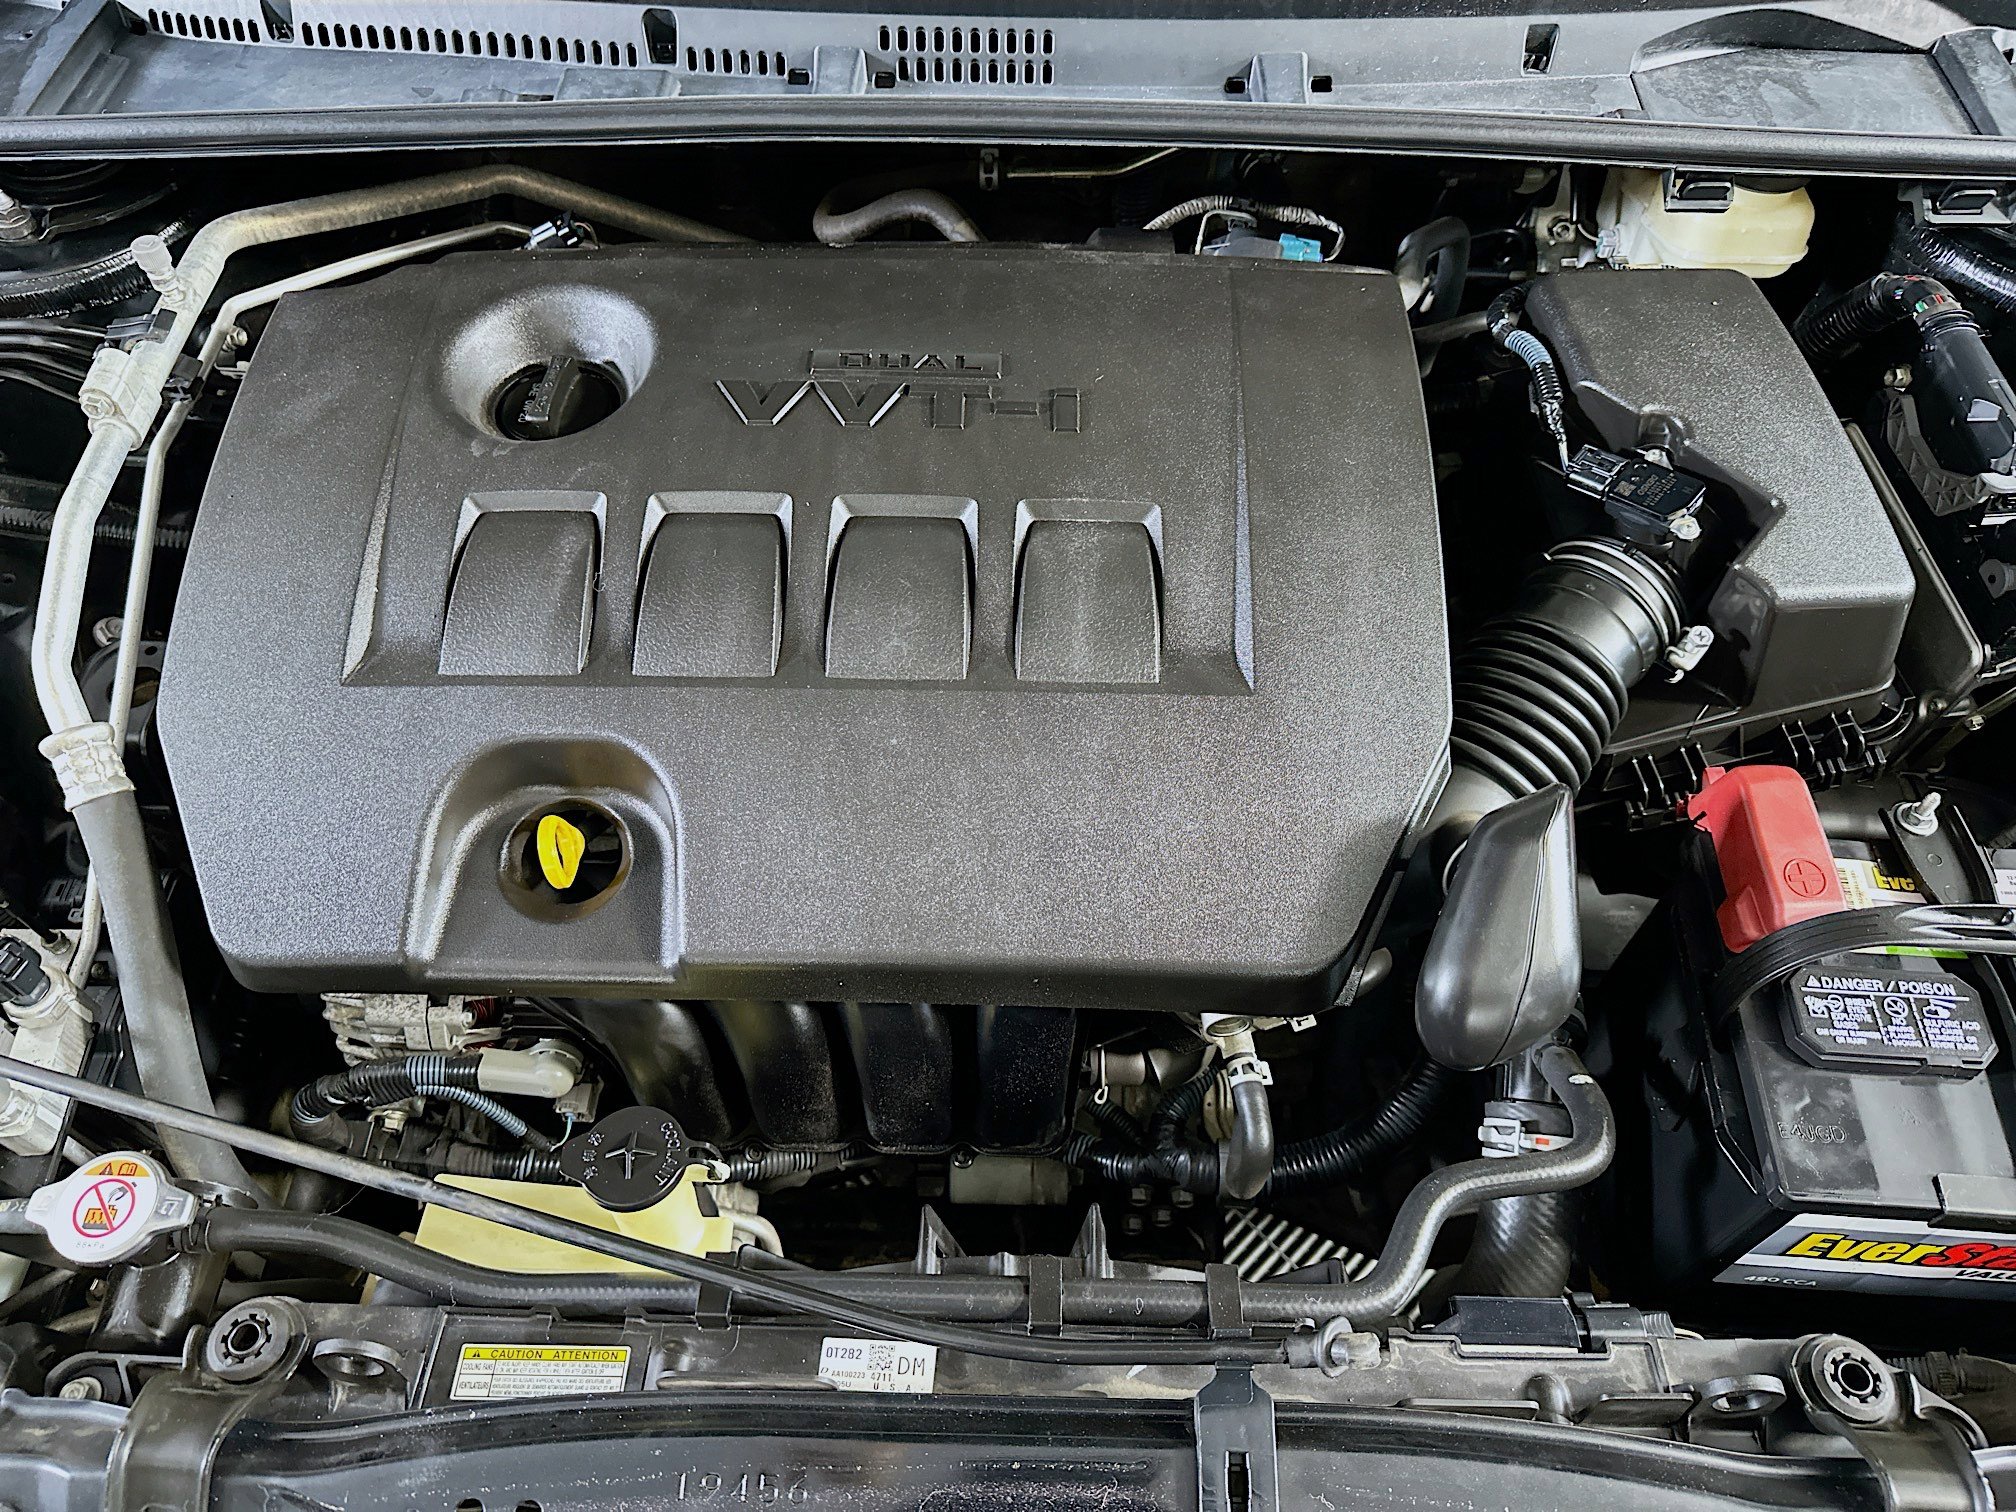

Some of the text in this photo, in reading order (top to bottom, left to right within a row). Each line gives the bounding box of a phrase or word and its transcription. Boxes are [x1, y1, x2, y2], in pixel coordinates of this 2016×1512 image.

[838, 352, 984, 371] DUAL
[1820, 976, 1885, 992] DANGER
[1898, 980, 1957, 996] POISON
[1782, 1278, 1817, 1287] CCA
[491, 1349, 619, 1360] CAUTION ATTENTION
[898, 1356, 926, 1377] DM
